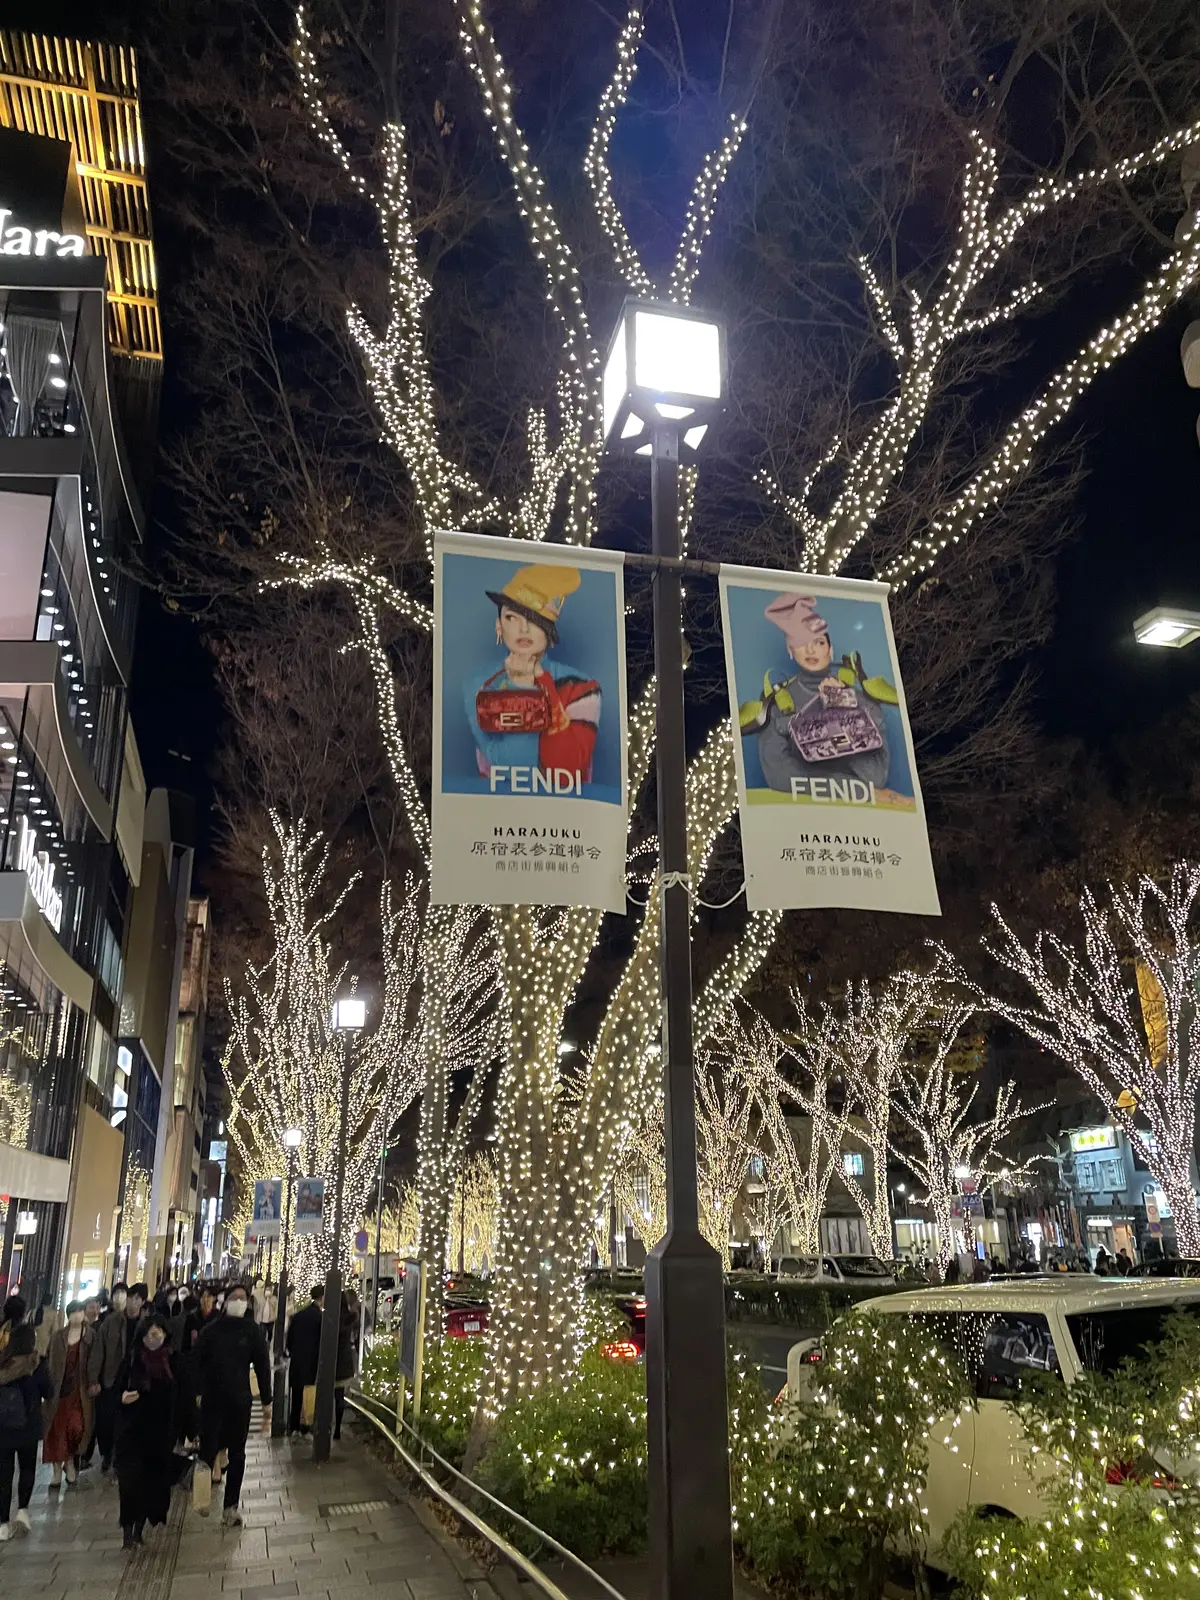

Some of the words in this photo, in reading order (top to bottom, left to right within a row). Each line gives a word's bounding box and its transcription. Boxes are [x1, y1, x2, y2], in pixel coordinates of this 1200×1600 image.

[0, 208, 84, 257] ara
[489, 765, 582, 796] FENDI
[790, 776, 876, 806] FENDI
[493, 826, 581, 839] HARAJUKU
[800, 833, 881, 846] HARAJUKU
